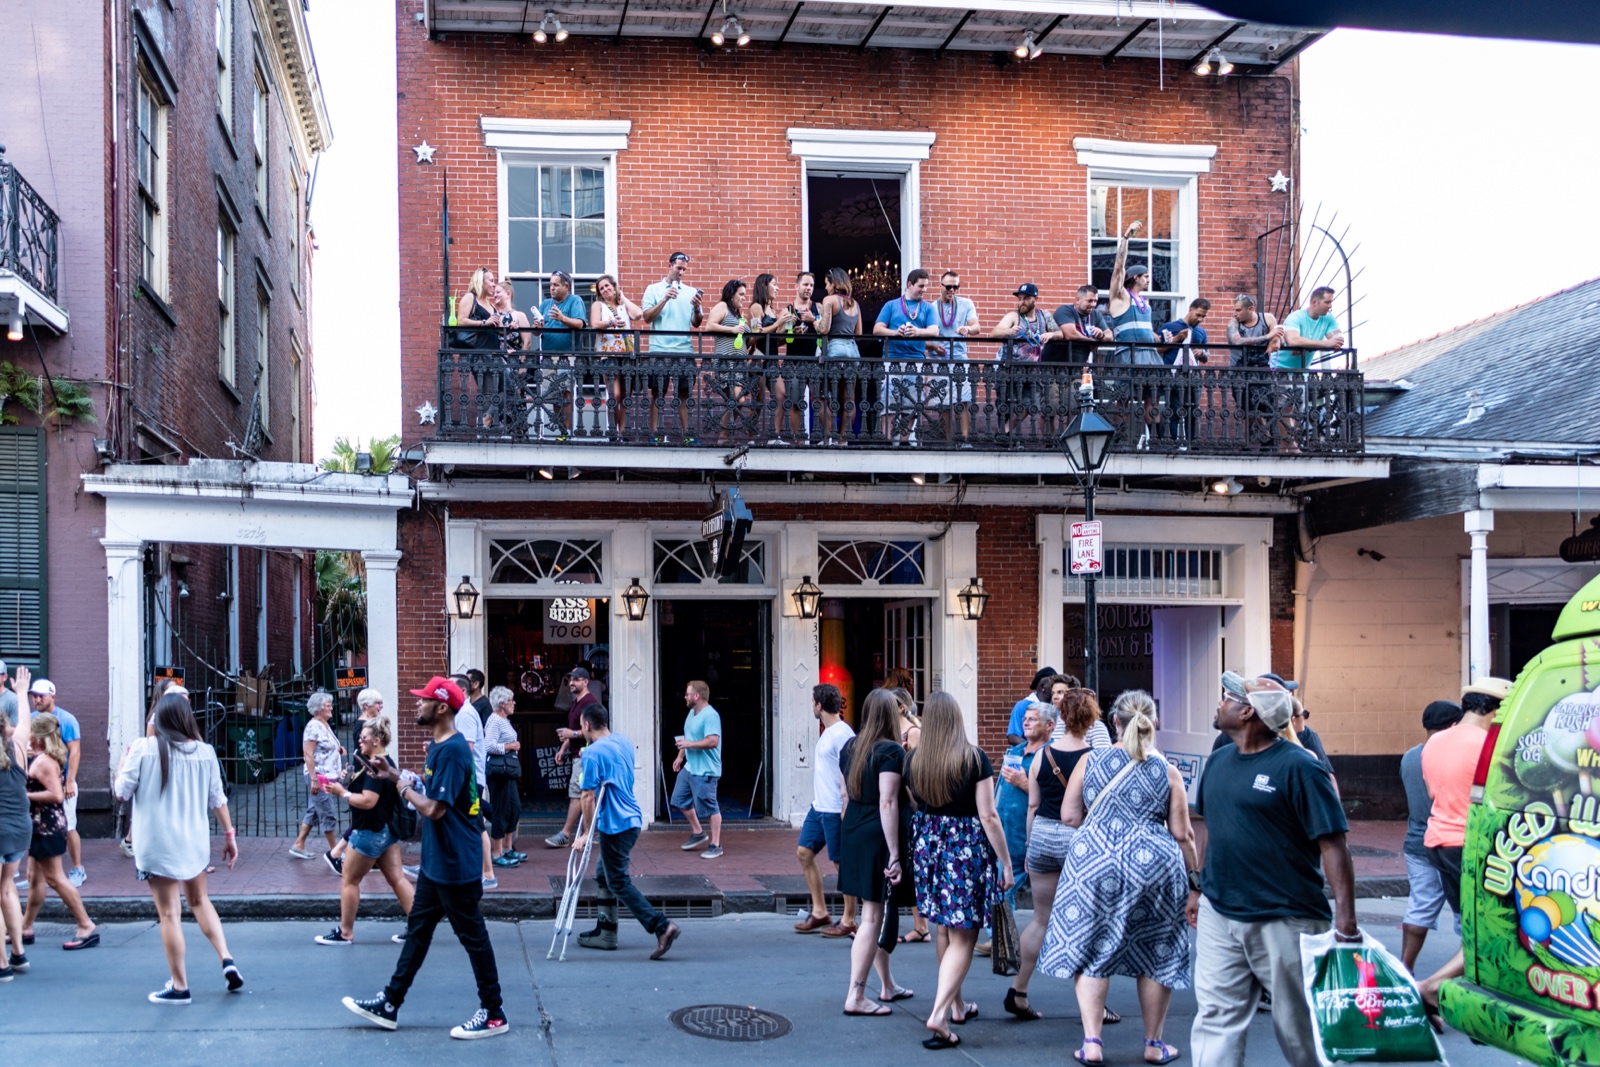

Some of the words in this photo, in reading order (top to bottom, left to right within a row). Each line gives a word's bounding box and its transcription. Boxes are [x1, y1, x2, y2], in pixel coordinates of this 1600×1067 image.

[1073, 525, 1082, 536] NO
[1078, 538, 1094, 548] FIRE
[1077, 548, 1095, 559] LANE
[550, 597, 589, 609] ASS
[549, 607, 592, 624] BEERS
[549, 625, 568, 638] TO
[570, 625, 592, 638] GO
[1129, 632, 1140, 657] &
[166, 667, 173, 677] NO
[347, 669, 355, 678] NO
[1554, 702, 1600, 718] PARADISE
[1554, 714, 1593, 733] KUSH
[1515, 732, 1548, 752] SOUR
[536, 746, 560, 759] BUY
[538, 757, 558, 768] GE
[540, 765, 571, 778] FREE
[548, 777, 567, 785] DILLY
[1484, 801, 1556, 896] WEED
[1528, 965, 1591, 1007] OVER
